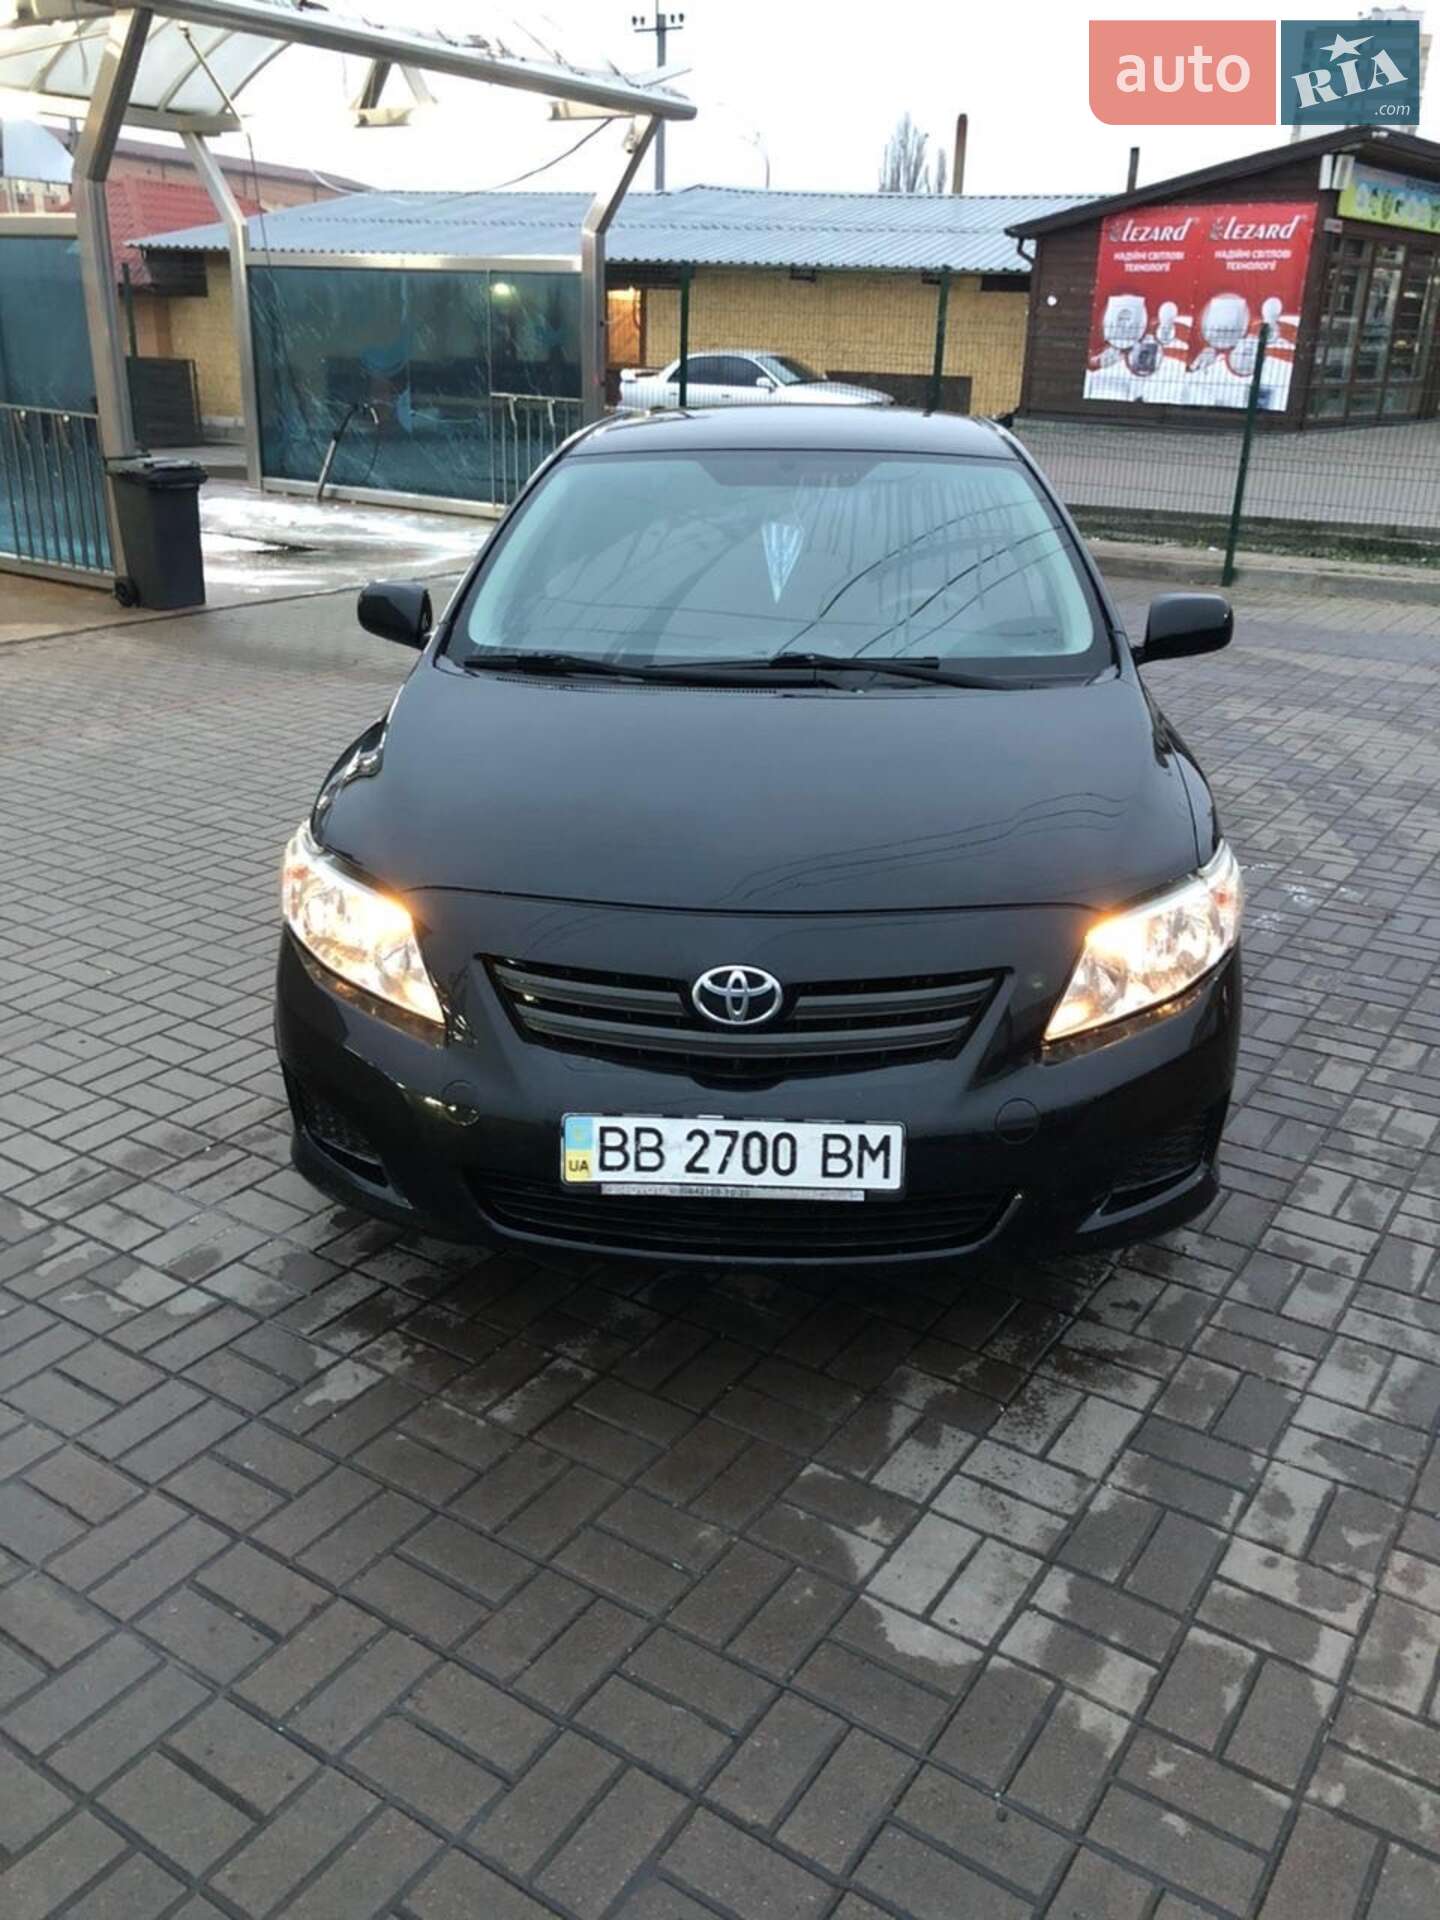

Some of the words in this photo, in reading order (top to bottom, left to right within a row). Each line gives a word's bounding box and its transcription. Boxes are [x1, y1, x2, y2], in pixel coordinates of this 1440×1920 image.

[568, 1159, 589, 1172] UA
[598, 1126, 666, 1173] BB
[684, 1128, 797, 1176] 2700
[820, 1133, 892, 1179] BM
